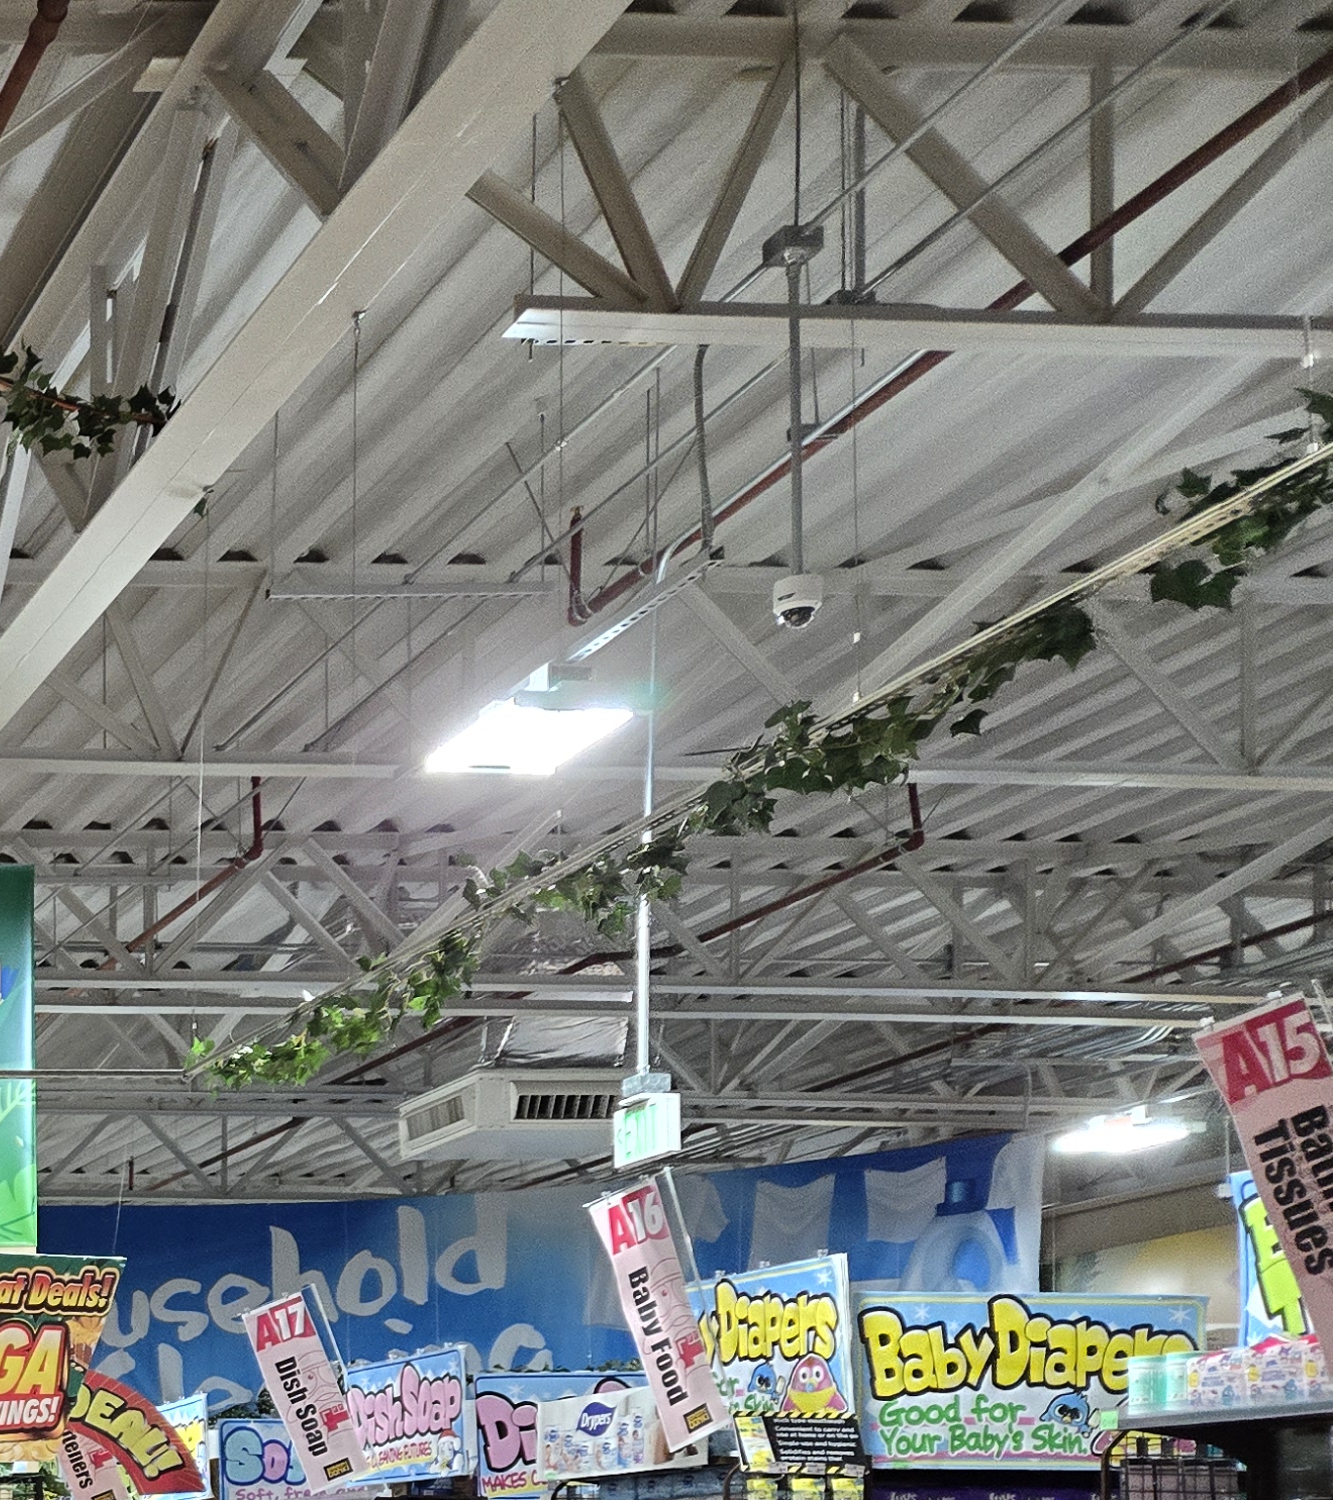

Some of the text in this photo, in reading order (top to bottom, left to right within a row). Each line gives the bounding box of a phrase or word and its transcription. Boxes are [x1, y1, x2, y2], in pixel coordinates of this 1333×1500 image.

[1222, 1010, 1321, 1104] A15
[607, 1190, 665, 1256] A16
[1253, 1119, 1333, 1276] Tissues
[28, 1272, 116, 1310] Deals!
[97, 1201, 509, 1348] usehold
[256, 1301, 309, 1352] A17
[627, 1265, 690, 1408] Baby Food
[715, 1279, 838, 1364] Diapers
[860, 1305, 995, 1402] Baby
[274, 1356, 330, 1458] Dish Soap
[346, 1383, 405, 1447] Dish
[399, 1364, 463, 1436] Soap
[878, 1395, 1028, 1431] Good for
[879, 1422, 1088, 1458] Your Baby's Skin.
[62, 1429, 94, 1490] teners
[481, 1473, 527, 1493] MAKES
